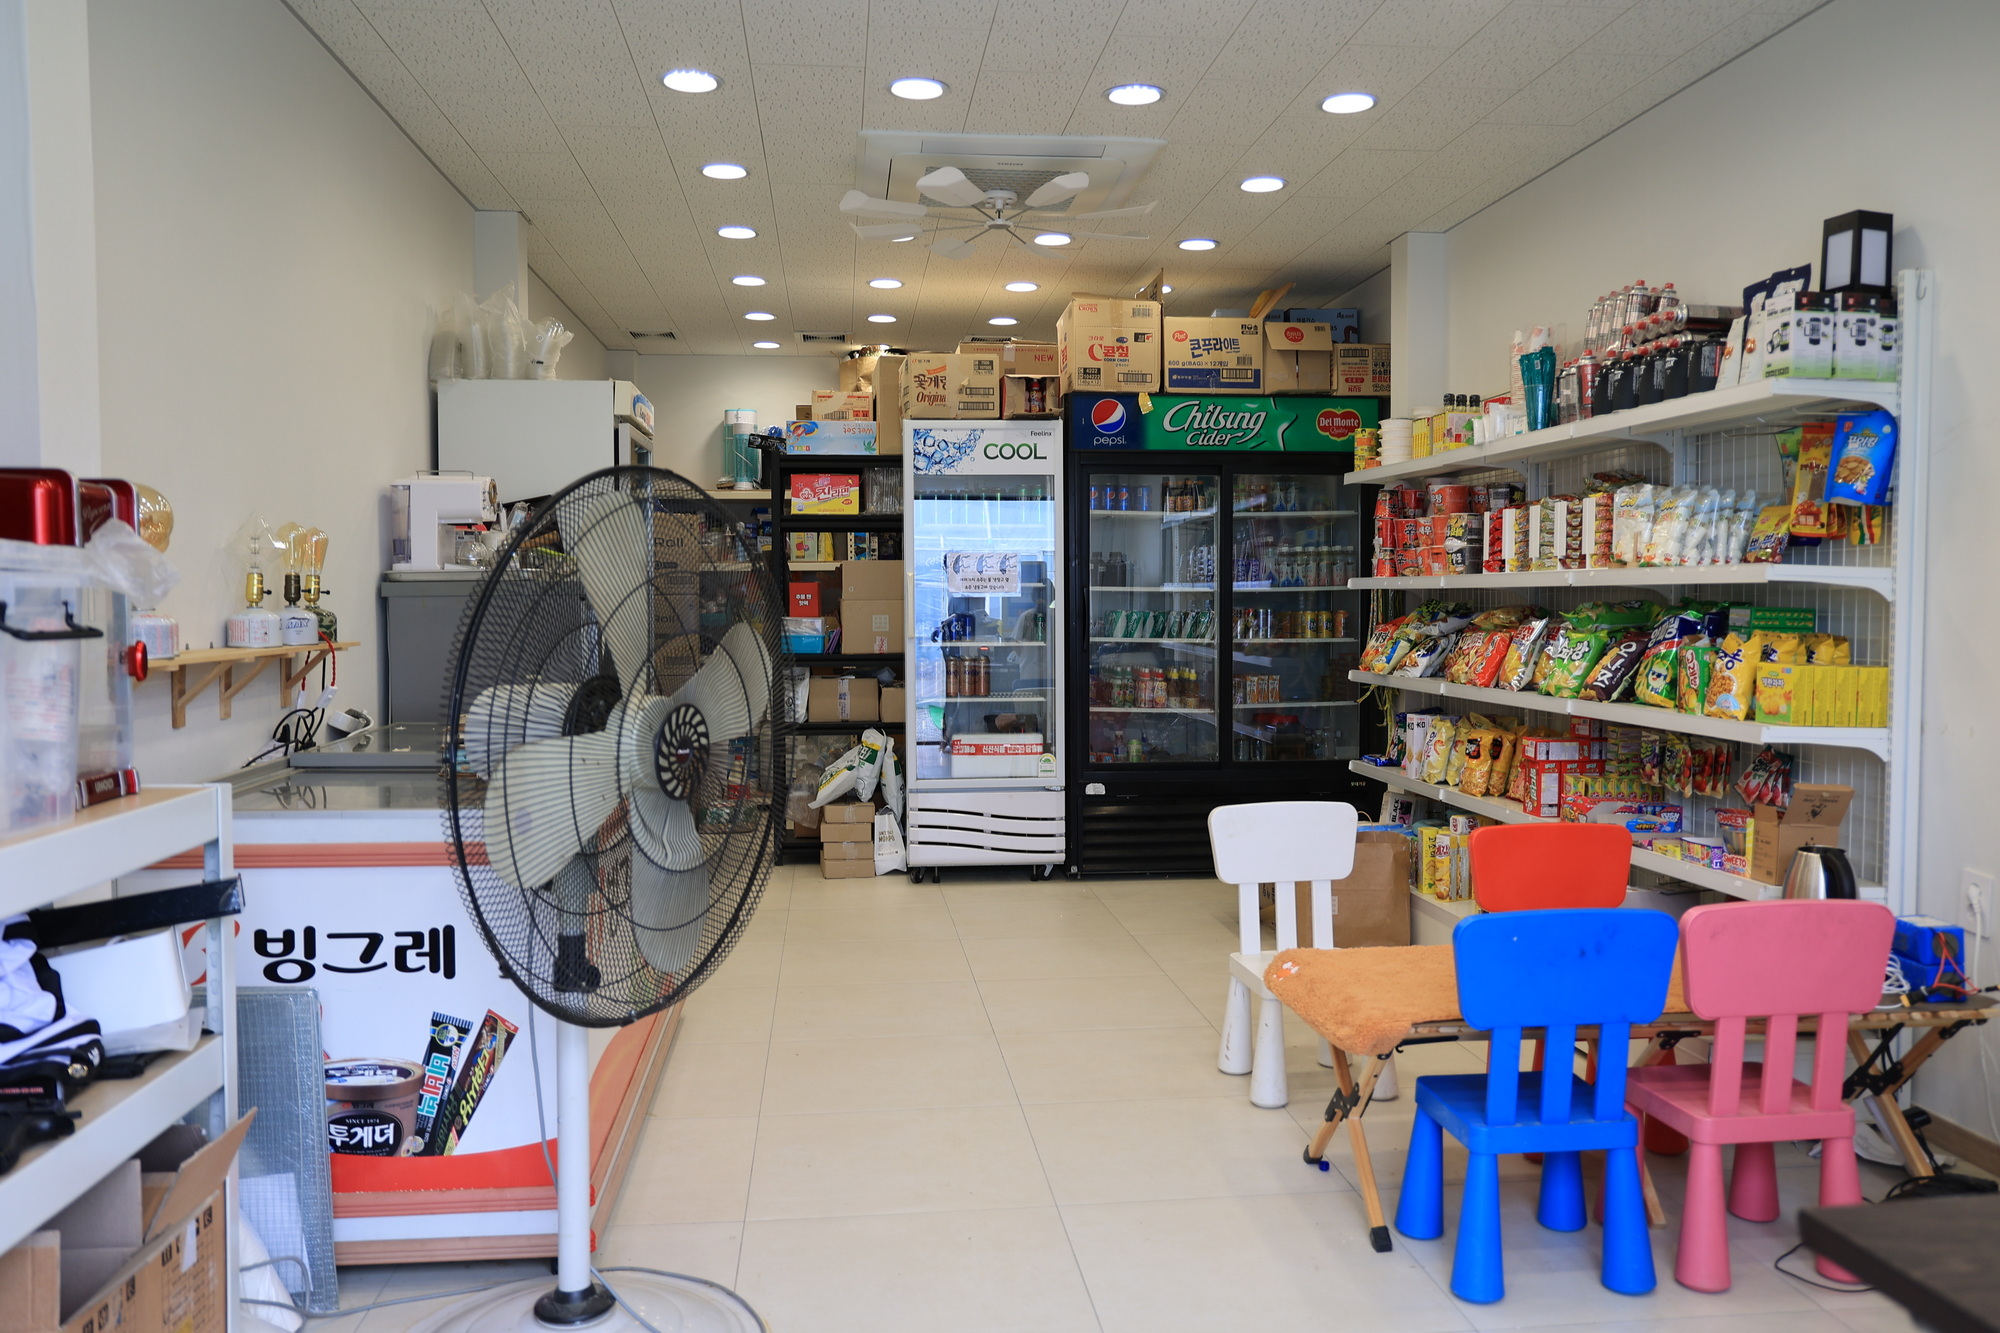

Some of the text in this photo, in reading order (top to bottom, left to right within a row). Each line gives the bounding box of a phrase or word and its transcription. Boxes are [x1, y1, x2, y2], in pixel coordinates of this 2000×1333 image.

[1173, 332, 1187, 341] Post
[1286, 331, 1302, 340] 햇반
[1102, 345, 1130, 358] 콘칩
[1189, 337, 1241, 359] 콘푸라이트
[1034, 354, 1054, 362] NEW
[1347, 385, 1362, 393] SUN
[916, 390, 947, 407] Origina
[1162, 400, 1267, 444] Chilsung
[1319, 417, 1359, 428] Del Monte
[1186, 429, 1245, 447] Cider
[983, 442, 1048, 460] COOL
[814, 484, 851, 502] 진라면
[1685, 649, 1699, 688] 고래밥
[1761, 676, 1785, 688] 계란과자
[1391, 798, 1400, 823] BLACK
[1660, 812, 1680, 821] PUSH
[1717, 812, 1748, 826] SWEET
[1723, 853, 1747, 868] SWEETO
[254, 924, 456, 984] 빙그레
[417, 1052, 451, 1118] 비비빅
[460, 1048, 490, 1126] 더위사냥
[328, 1123, 395, 1149] 투게더
